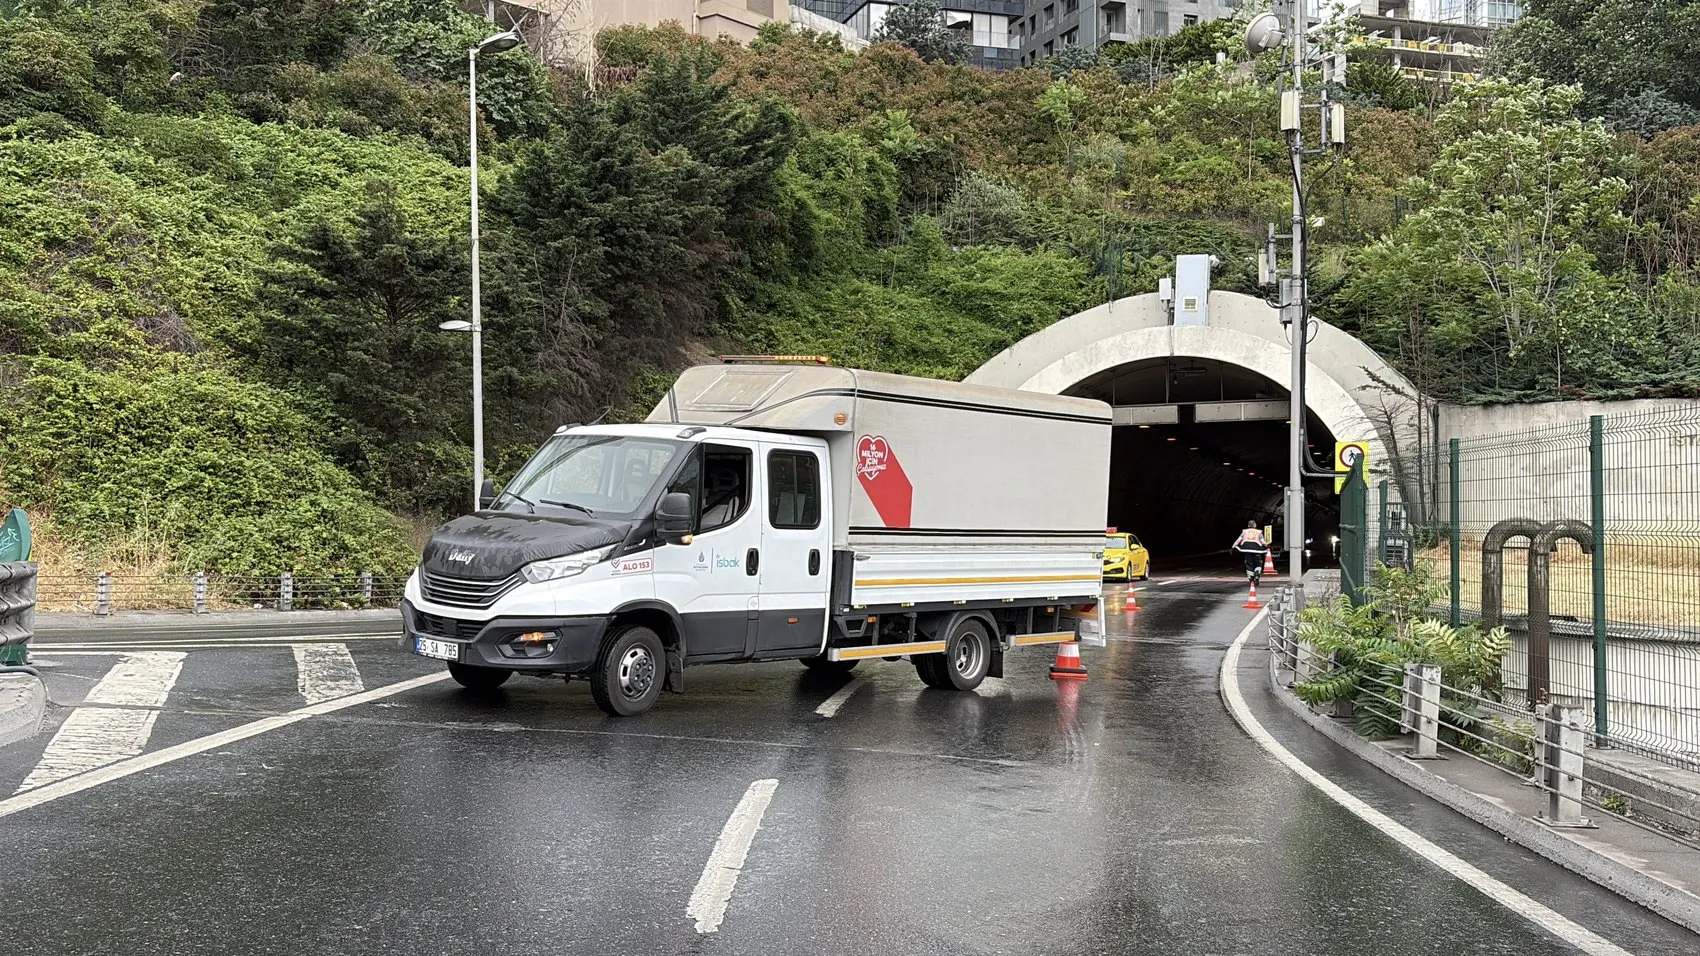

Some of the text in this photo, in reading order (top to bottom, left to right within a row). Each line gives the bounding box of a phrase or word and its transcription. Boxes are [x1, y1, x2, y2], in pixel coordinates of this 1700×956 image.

[623, 561, 650, 571] ALO 153
[431, 642, 438, 653] SA
[444, 644, 457, 656] 785
